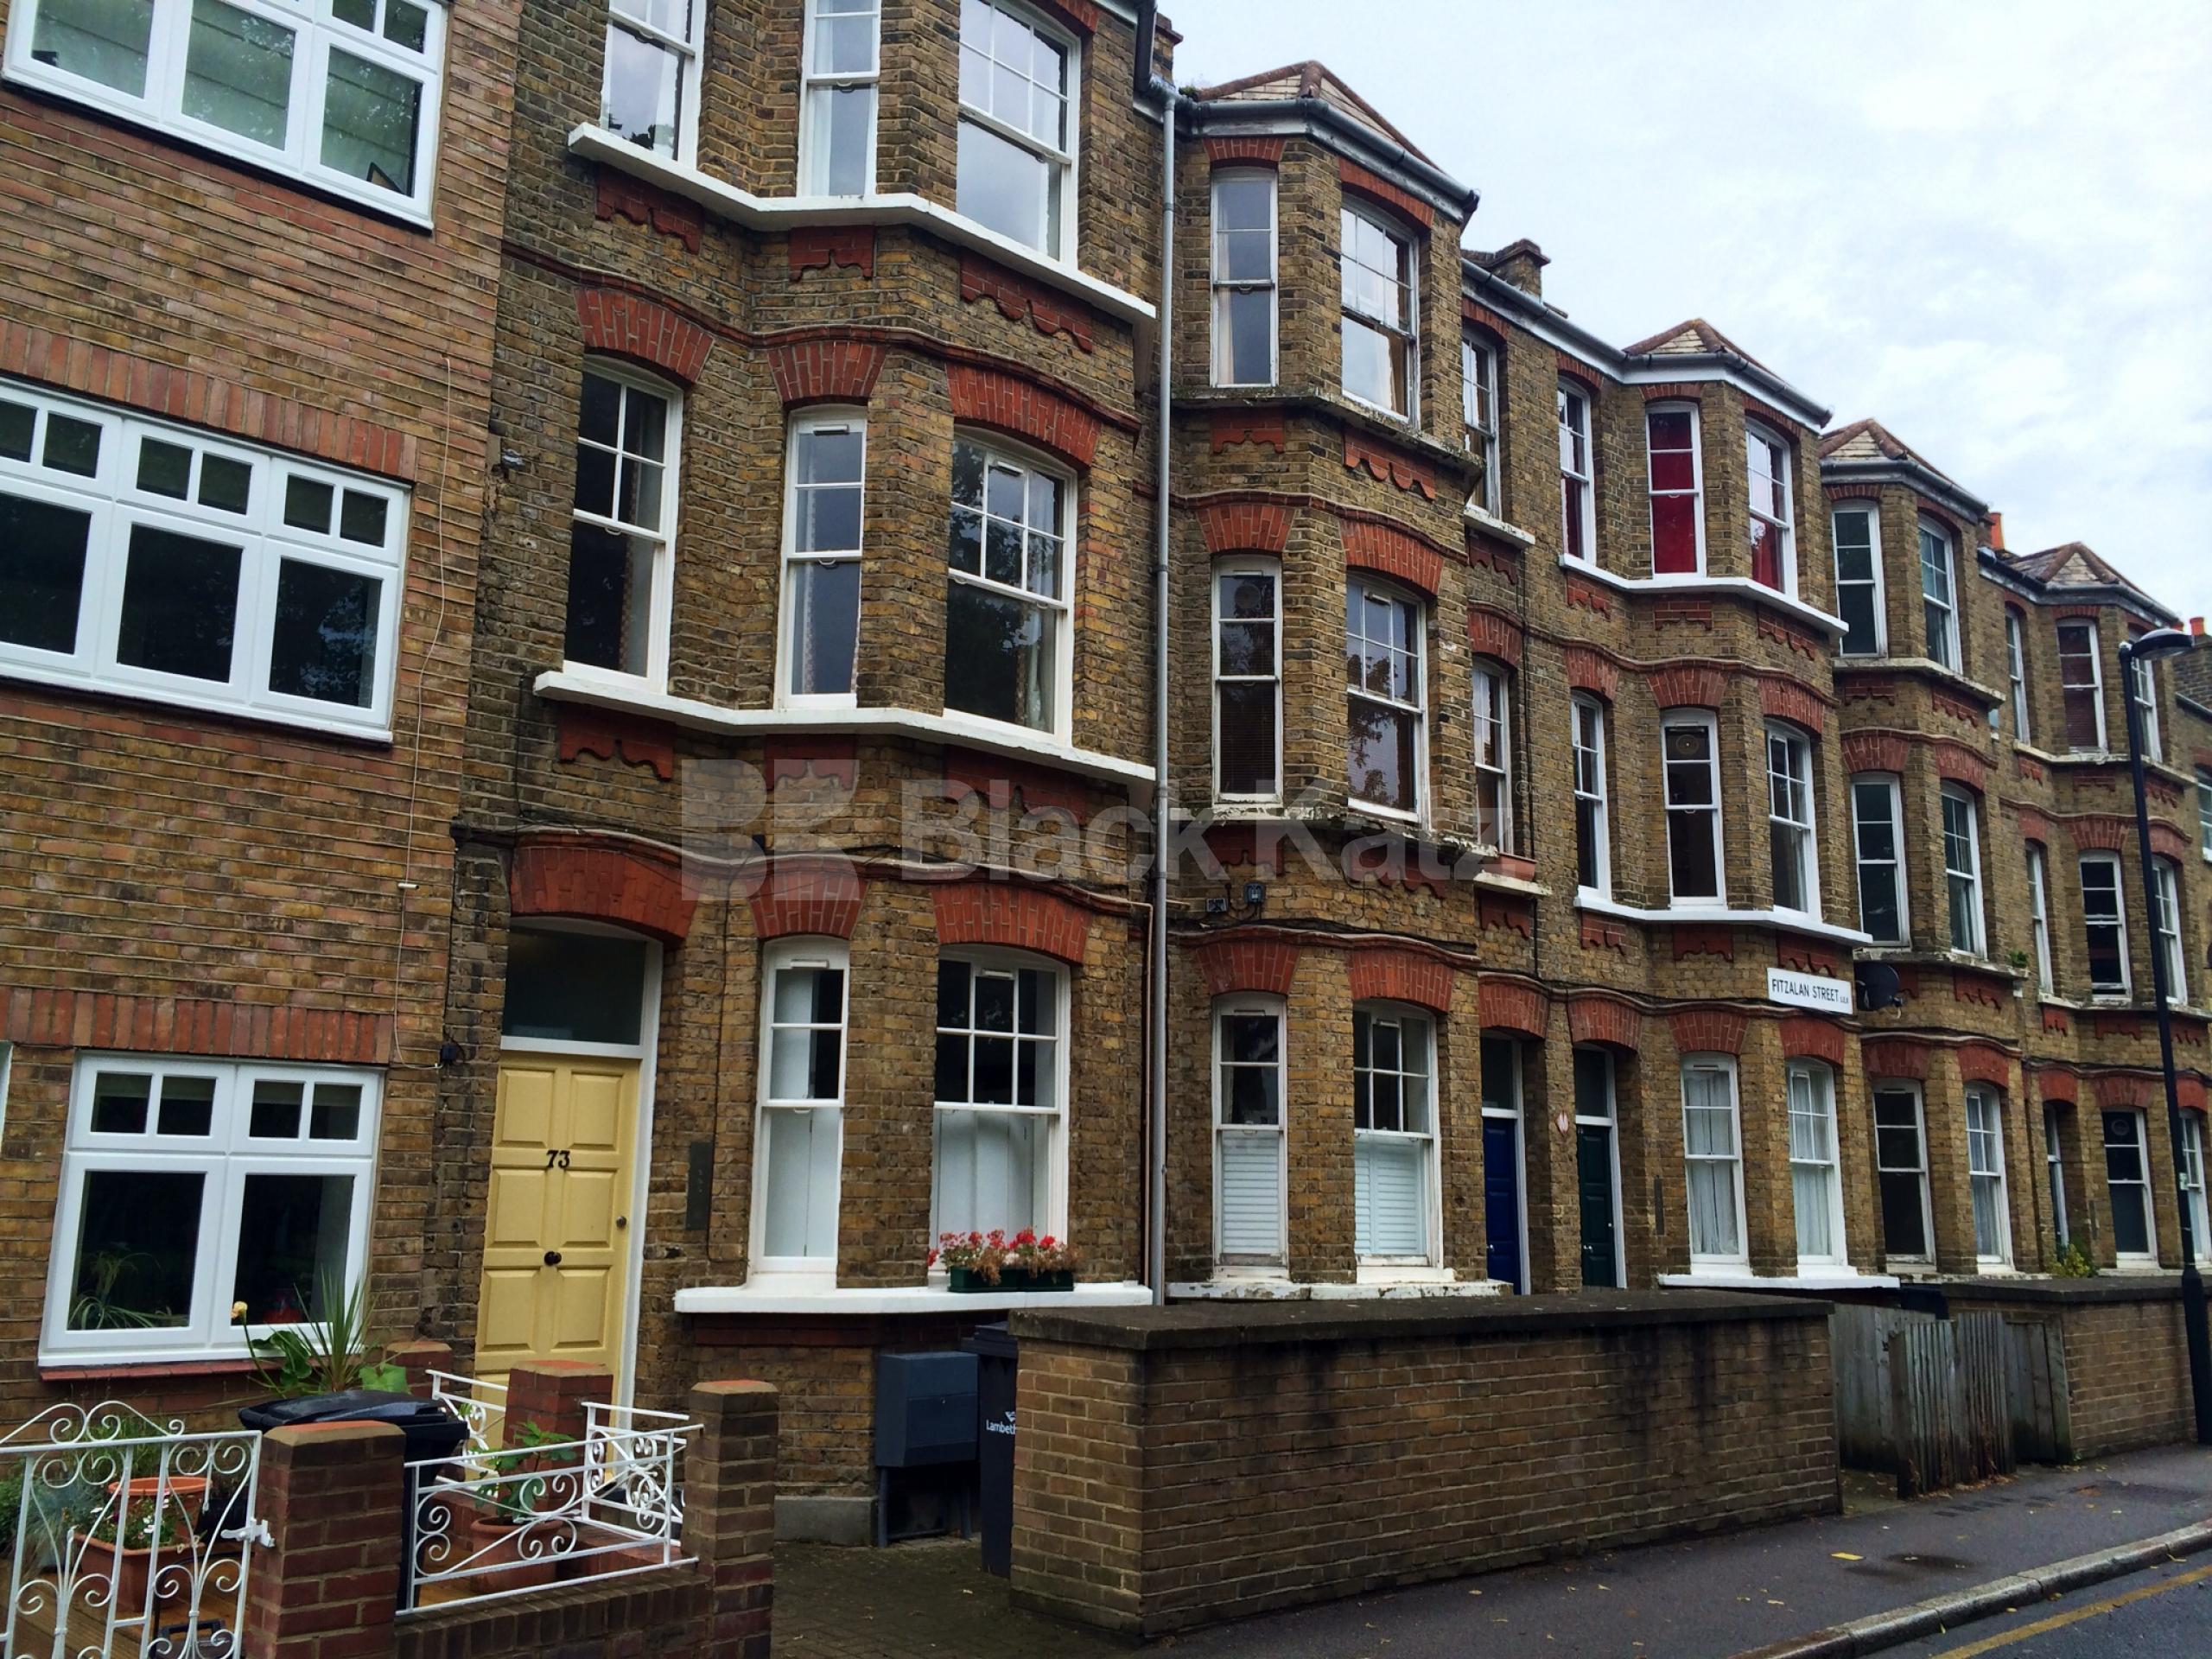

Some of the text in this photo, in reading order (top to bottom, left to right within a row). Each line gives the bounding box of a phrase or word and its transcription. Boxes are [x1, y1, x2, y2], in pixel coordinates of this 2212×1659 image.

[1771, 979, 1810, 998] FITZALAN
[1813, 986, 1840, 1002] STREET
[546, 1149, 571, 1169] 73
